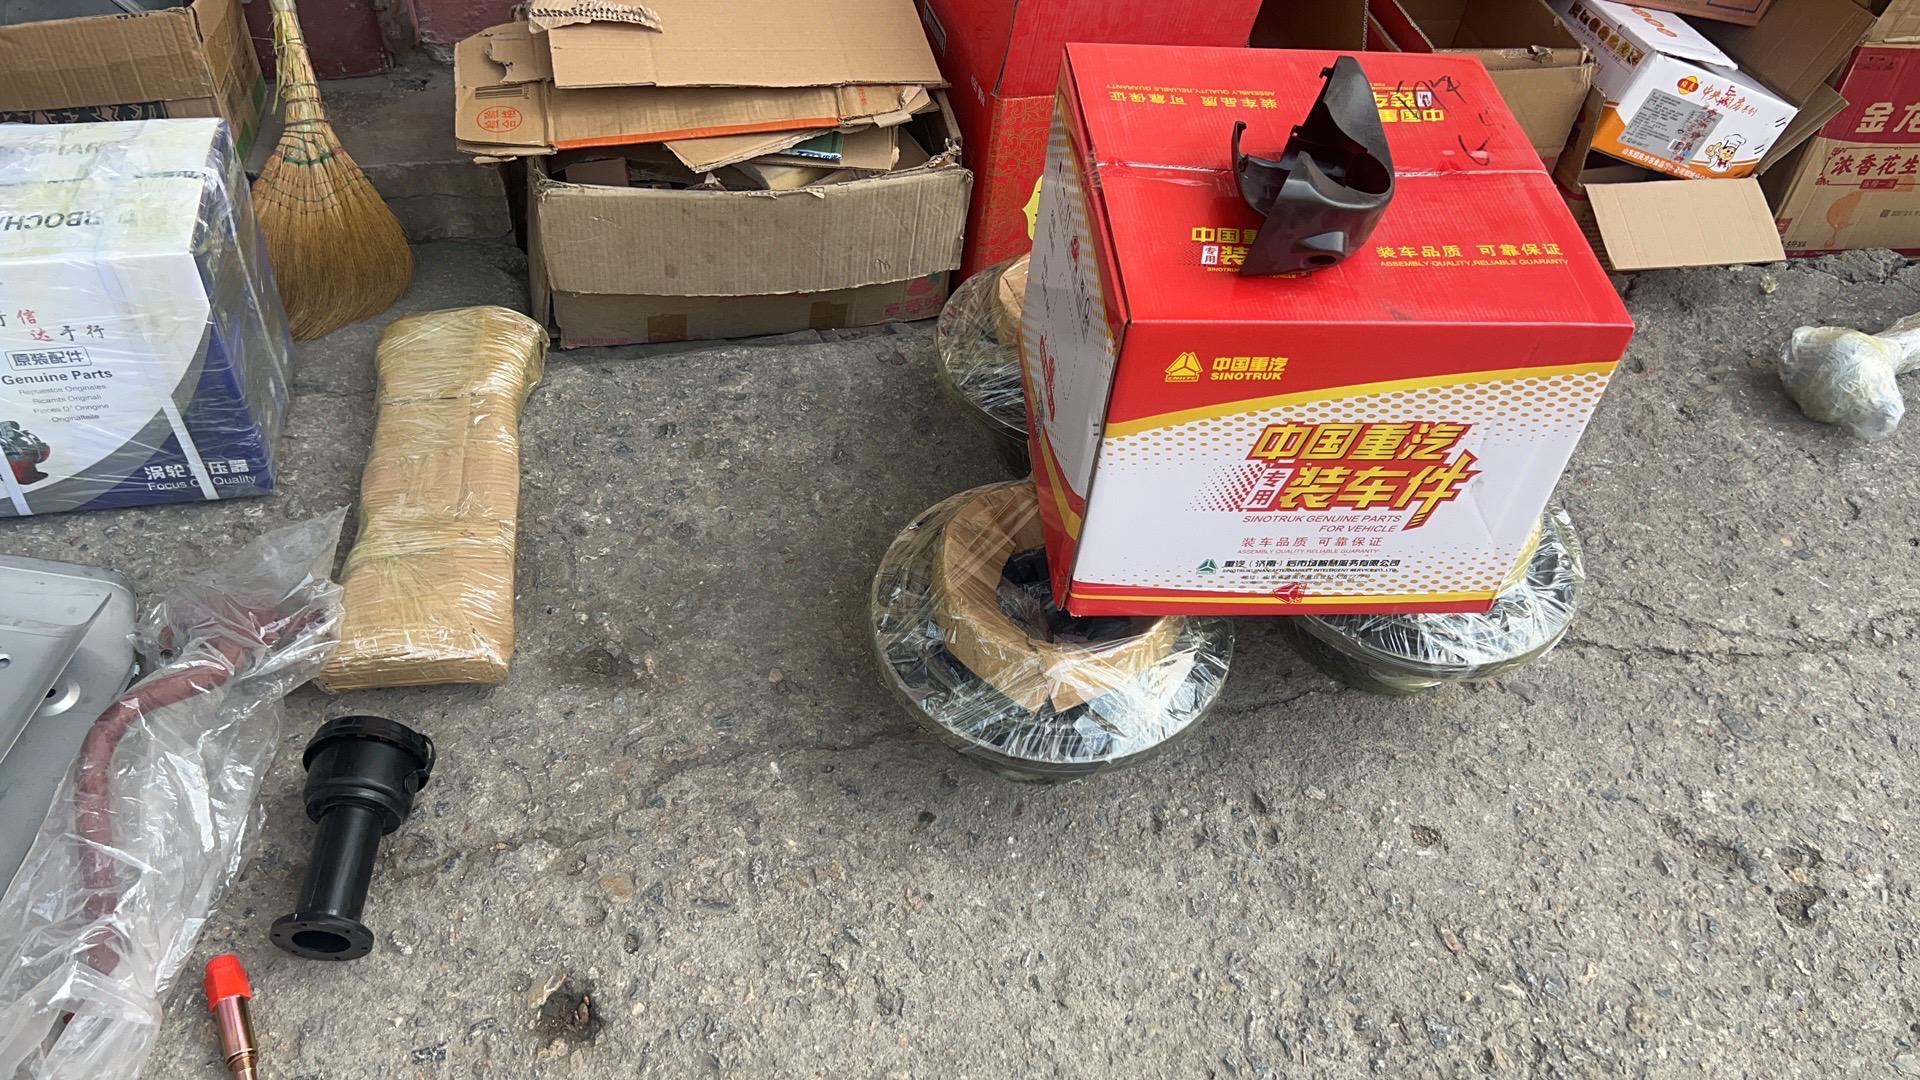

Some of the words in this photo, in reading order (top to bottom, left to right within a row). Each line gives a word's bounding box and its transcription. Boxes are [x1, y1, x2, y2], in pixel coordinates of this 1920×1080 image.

[1109, 91, 1187, 105] 可靠保证
[1201, 95, 1278, 109] 装车品质
[1831, 154, 1919, 176] 浓香花生
[1203, 247, 1216, 263] 专用
[1376, 244, 1463, 258] 装车品质
[1475, 243, 1564, 257] 可靠保证
[1380, 259, 1429, 268] ASSEMBLY
[1519, 258, 1569, 266] GUARANTY
[12, 350, 84, 367] 原装配件
[1212, 356, 1289, 372] 中国重汽
[1, 373, 68, 385] Genuine
[71, 369, 113, 380] Parts
[1210, 372, 1282, 381] SINOTRUK
[1252, 423, 1468, 460] 中国重汽
[144, 459, 250, 480] 涡轮压器
[147, 481, 188, 491] Focus
[212, 475, 256, 485] Quality
[1250, 471, 1288, 506] 专用
[1279, 452, 1474, 529] 装车件
[1242, 515, 1304, 523] SINOTRUK
[1306, 515, 1360, 523] GENUINE
[1362, 515, 1402, 523] PARTS
[1241, 536, 1309, 548] 装车品质
[1318, 536, 1384, 548] 可靠保证
